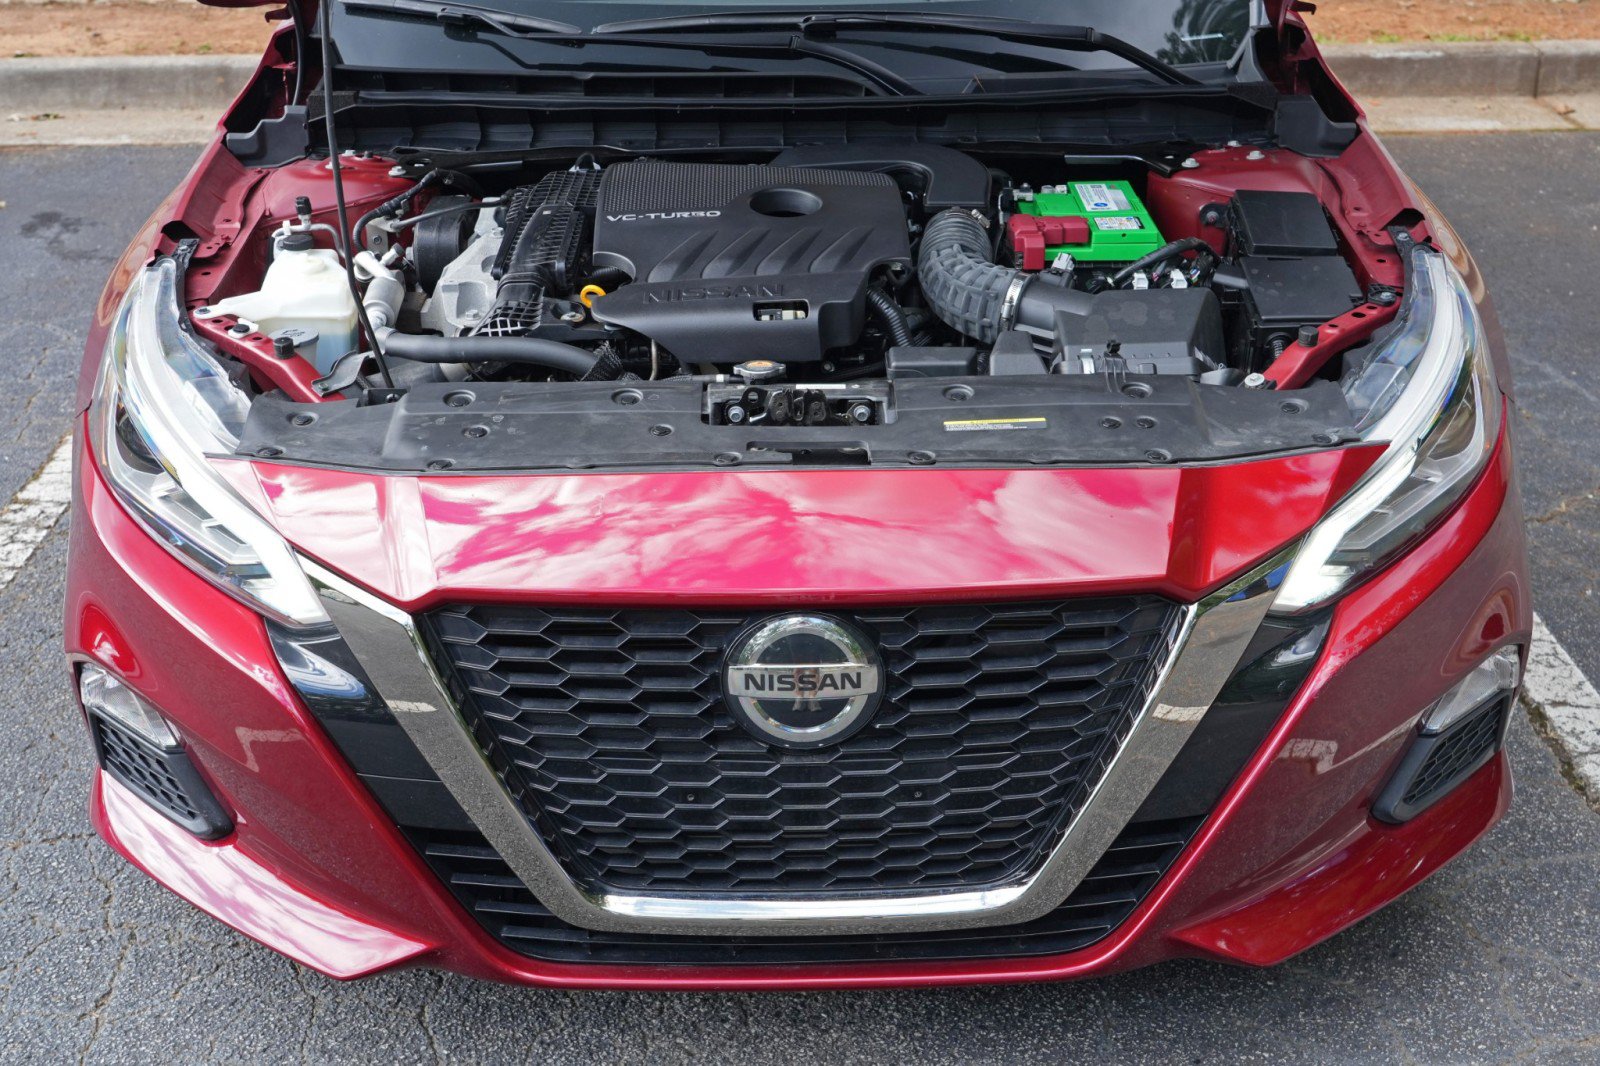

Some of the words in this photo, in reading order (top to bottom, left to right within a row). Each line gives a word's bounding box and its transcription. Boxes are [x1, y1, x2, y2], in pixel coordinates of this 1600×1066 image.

[606, 210, 722, 222] VC-TURBO
[643, 283, 784, 304] NISSAN
[744, 671, 862, 692] NISSAN
